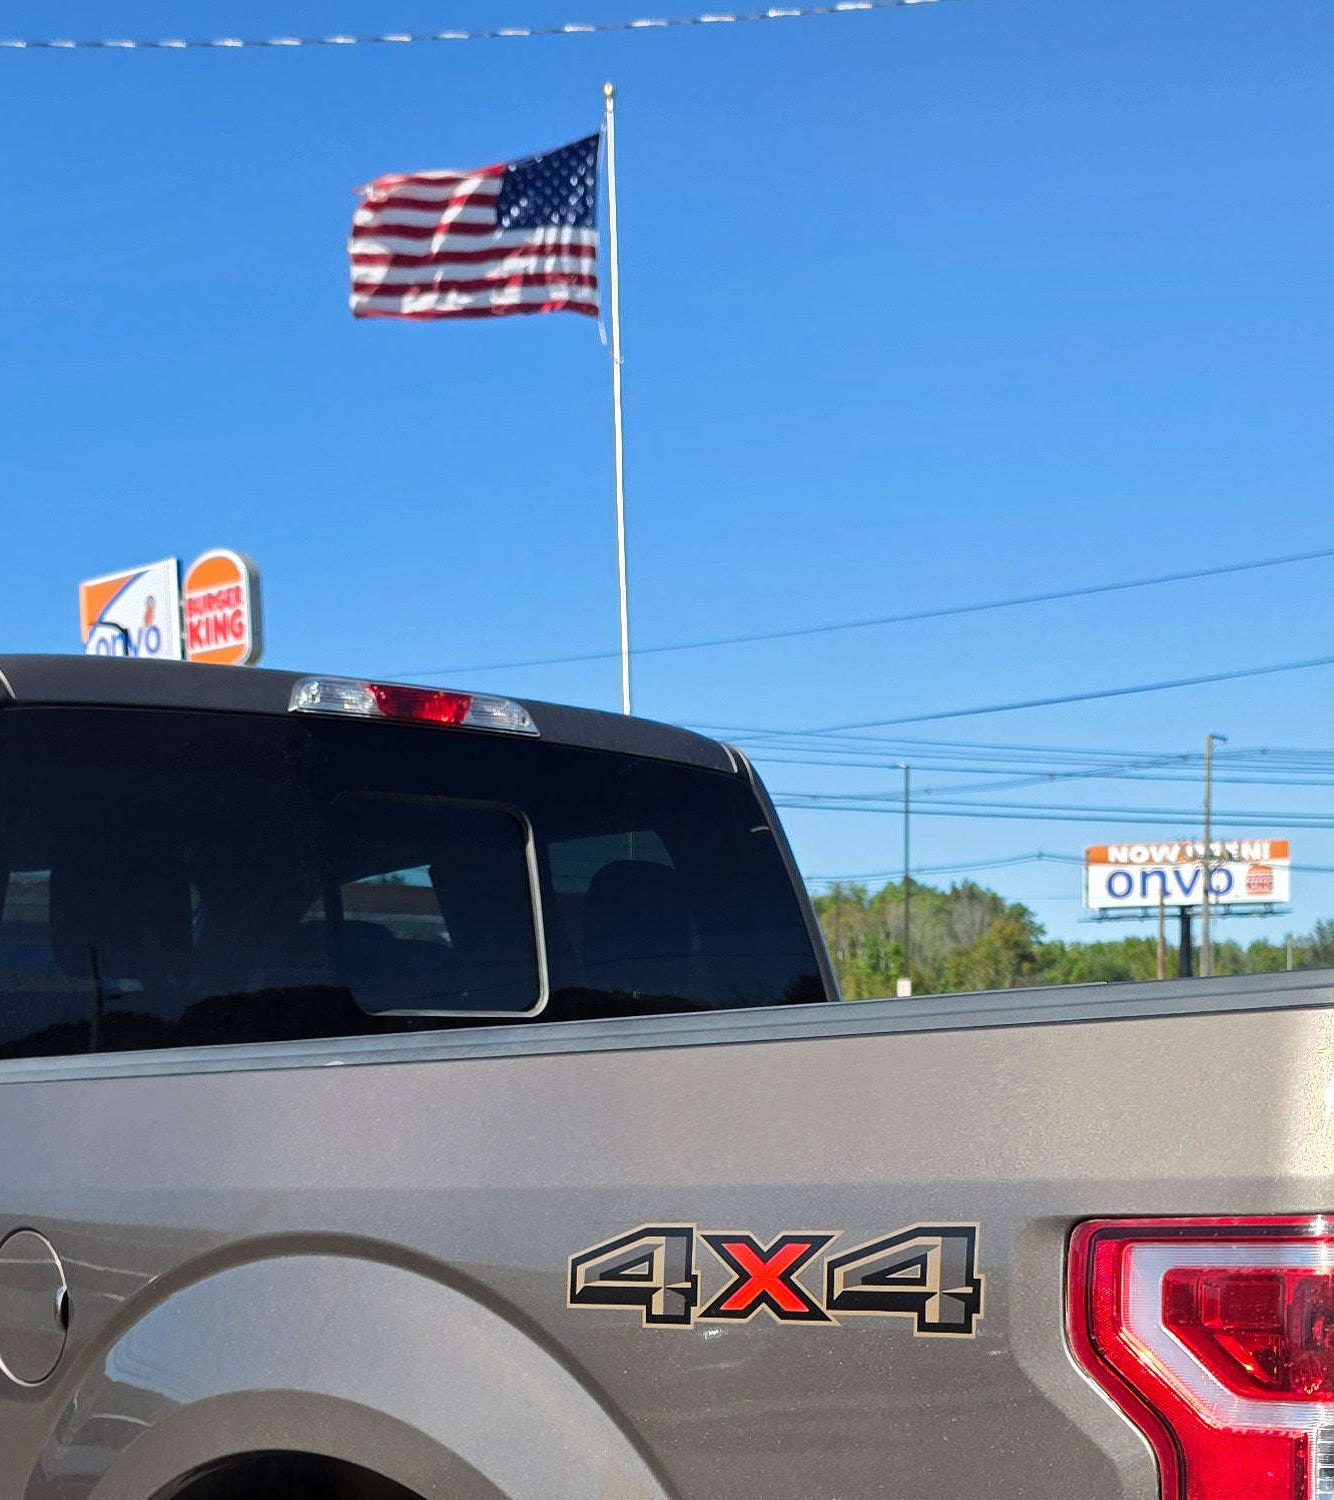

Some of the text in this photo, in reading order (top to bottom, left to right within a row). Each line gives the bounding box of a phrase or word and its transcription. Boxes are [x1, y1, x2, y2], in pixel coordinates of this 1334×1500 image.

[188, 610, 244, 649] KING
[1108, 844, 1180, 864] NOW
[1106, 867, 1234, 900] onvo
[567, 1221, 986, 1339] 4X4
